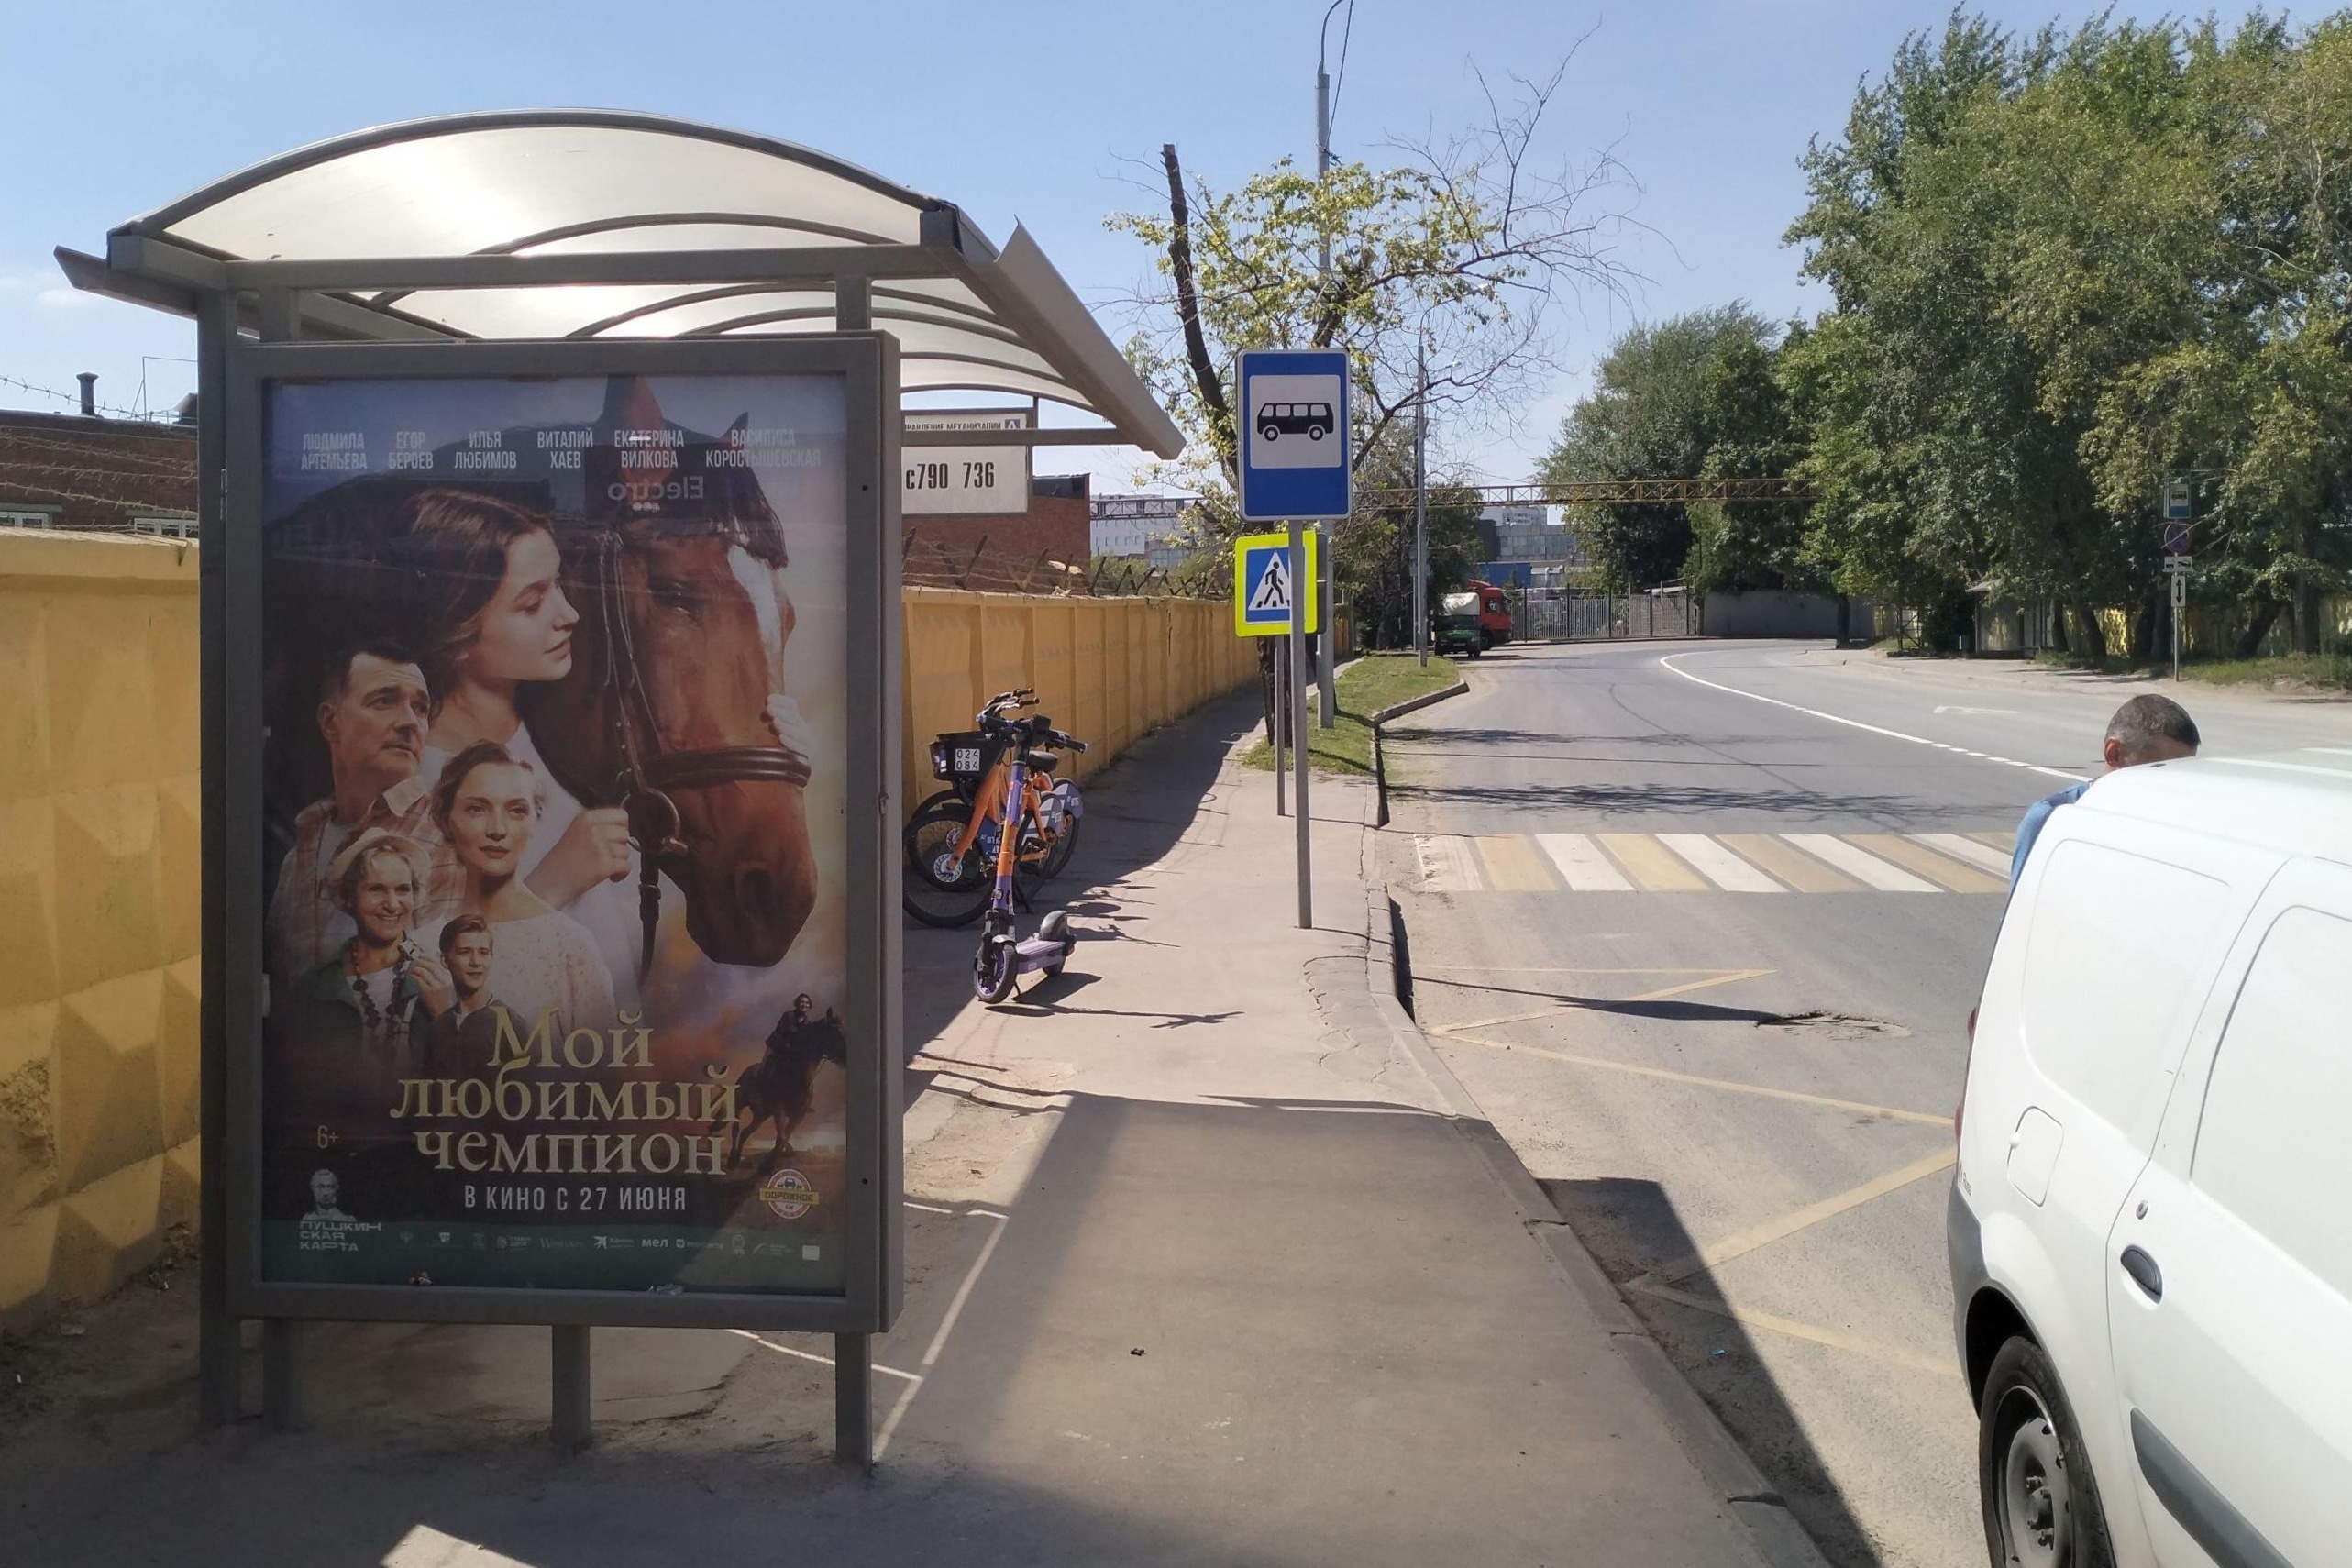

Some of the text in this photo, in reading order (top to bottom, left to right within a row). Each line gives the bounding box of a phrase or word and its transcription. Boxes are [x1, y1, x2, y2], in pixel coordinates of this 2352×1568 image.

[302, 431, 365, 451] ЛЮДМИЛА
[395, 431, 426, 450] ЕГОР
[469, 430, 502, 449] ИЛЬЯ
[536, 427, 594, 449] ВИТАЛИЙ
[613, 429, 684, 447] ЕКАТЕРИНА
[731, 428, 796, 447] ВАСИЛИСА
[300, 451, 368, 471] АРТЕМЬЕВА
[388, 451, 434, 470] БЕРОЕВ
[454, 450, 517, 469] ЛЮБИМОВ
[549, 450, 581, 469] ХАЕВ
[621, 450, 679, 469] ВИЛКОВА
[705, 448, 822, 468] КОРОСТЫШЕВСКАЯ
[962, 461, 995, 489] 736
[956, 749, 979, 760] 024
[955, 760, 979, 771] 084
[486, 1006, 655, 1069] Мой
[390, 1055, 741, 1123] любимый
[316, 1124, 339, 1149] 6+
[412, 1130, 727, 1176] чемпион
[463, 1184, 687, 1212] В КИНО С 27 ИЮНЯ
[299, 1221, 382, 1231] ПУШКИН
[299, 1231, 346, 1241] СКАЯ
[641, 1239, 669, 1249] мел
[299, 1242, 359, 1252] КАРТА
